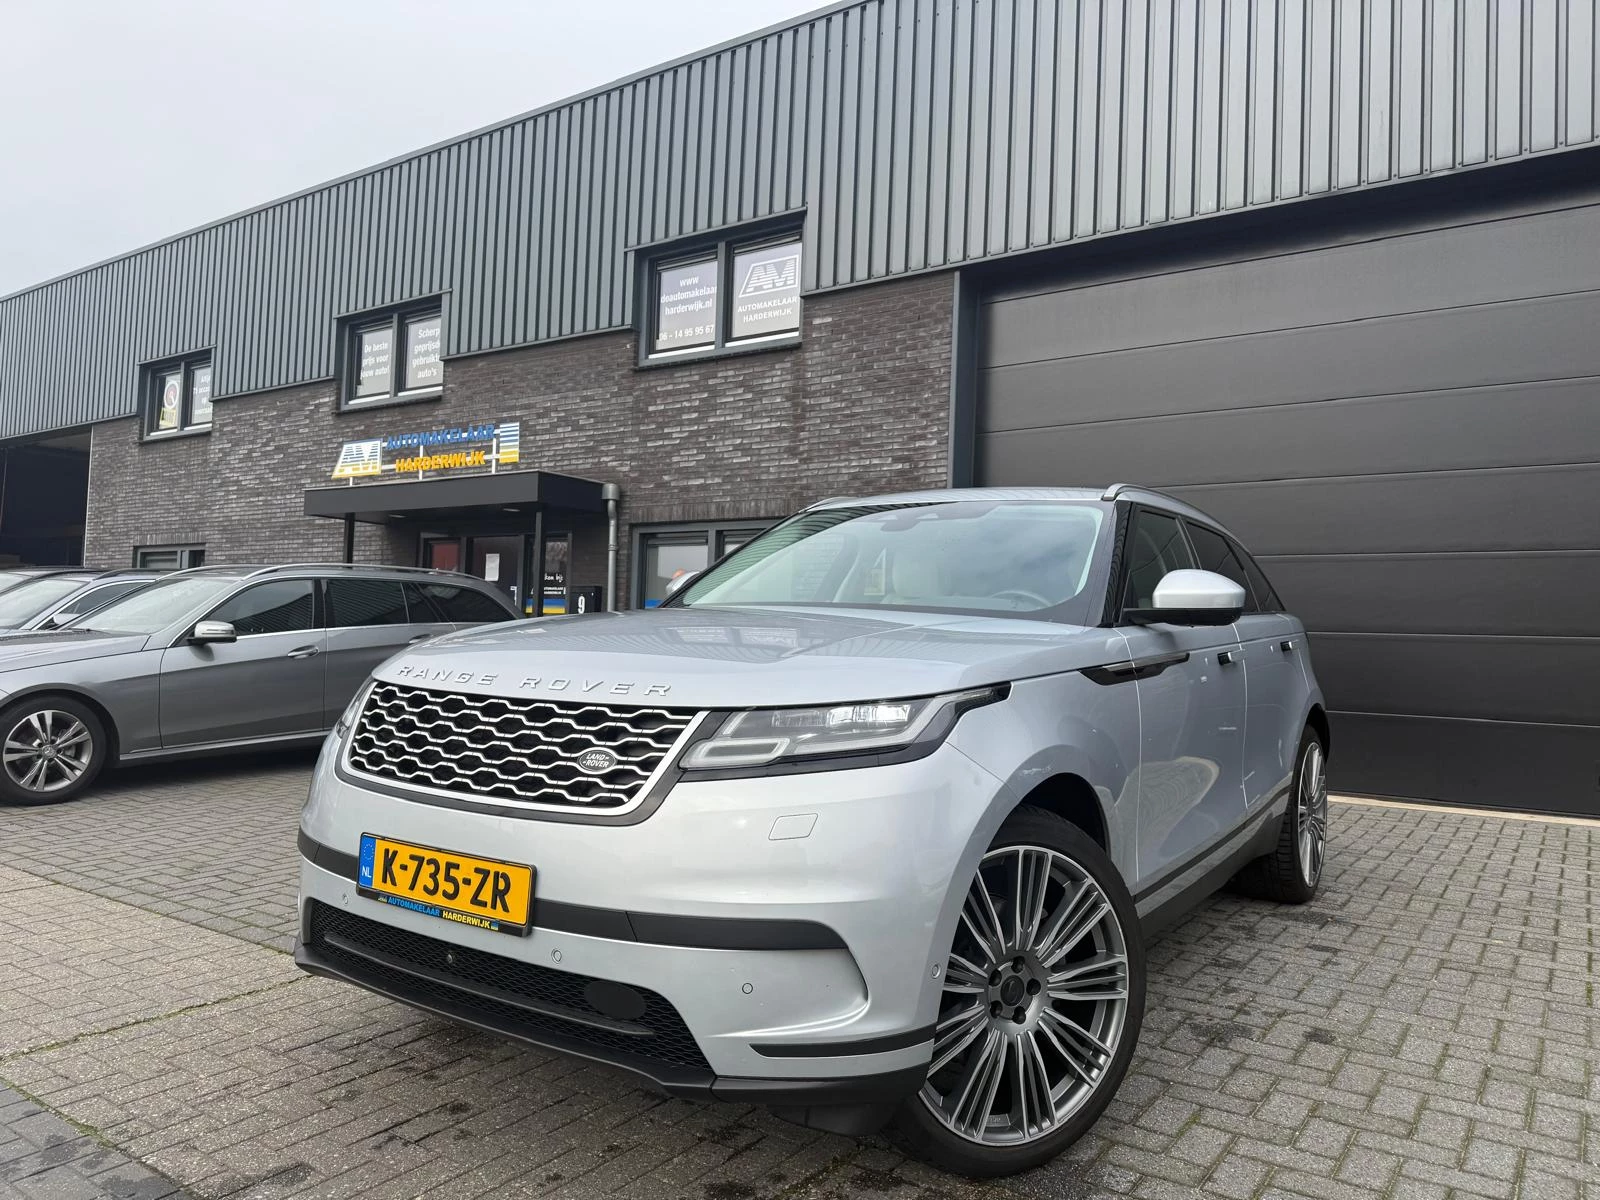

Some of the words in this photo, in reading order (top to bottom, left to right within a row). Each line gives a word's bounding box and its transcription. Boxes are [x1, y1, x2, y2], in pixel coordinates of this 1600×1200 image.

[679, 275, 699, 287] www
[664, 298, 712, 315] harderwijk.nl
[737, 296, 798, 313] AUTOMAKELAAR
[743, 308, 792, 323] HARDERWIJK
[418, 328, 440, 339] Scherp
[674, 330, 683, 339] 14
[414, 340, 440, 355] geprijsd
[386, 424, 496, 450] AUTOMAKELAAR
[395, 450, 486, 473] HARDERWIJK
[577, 595, 586, 614] 9
[397, 664, 498, 686] RANGE
[518, 676, 672, 696] ROVER
[361, 865, 372, 879] NL
[381, 847, 511, 913] K-735-ZR
[387, 896, 440, 917] AUTOMAKELAAR
[442, 910, 491, 929] HARDERWIJK
